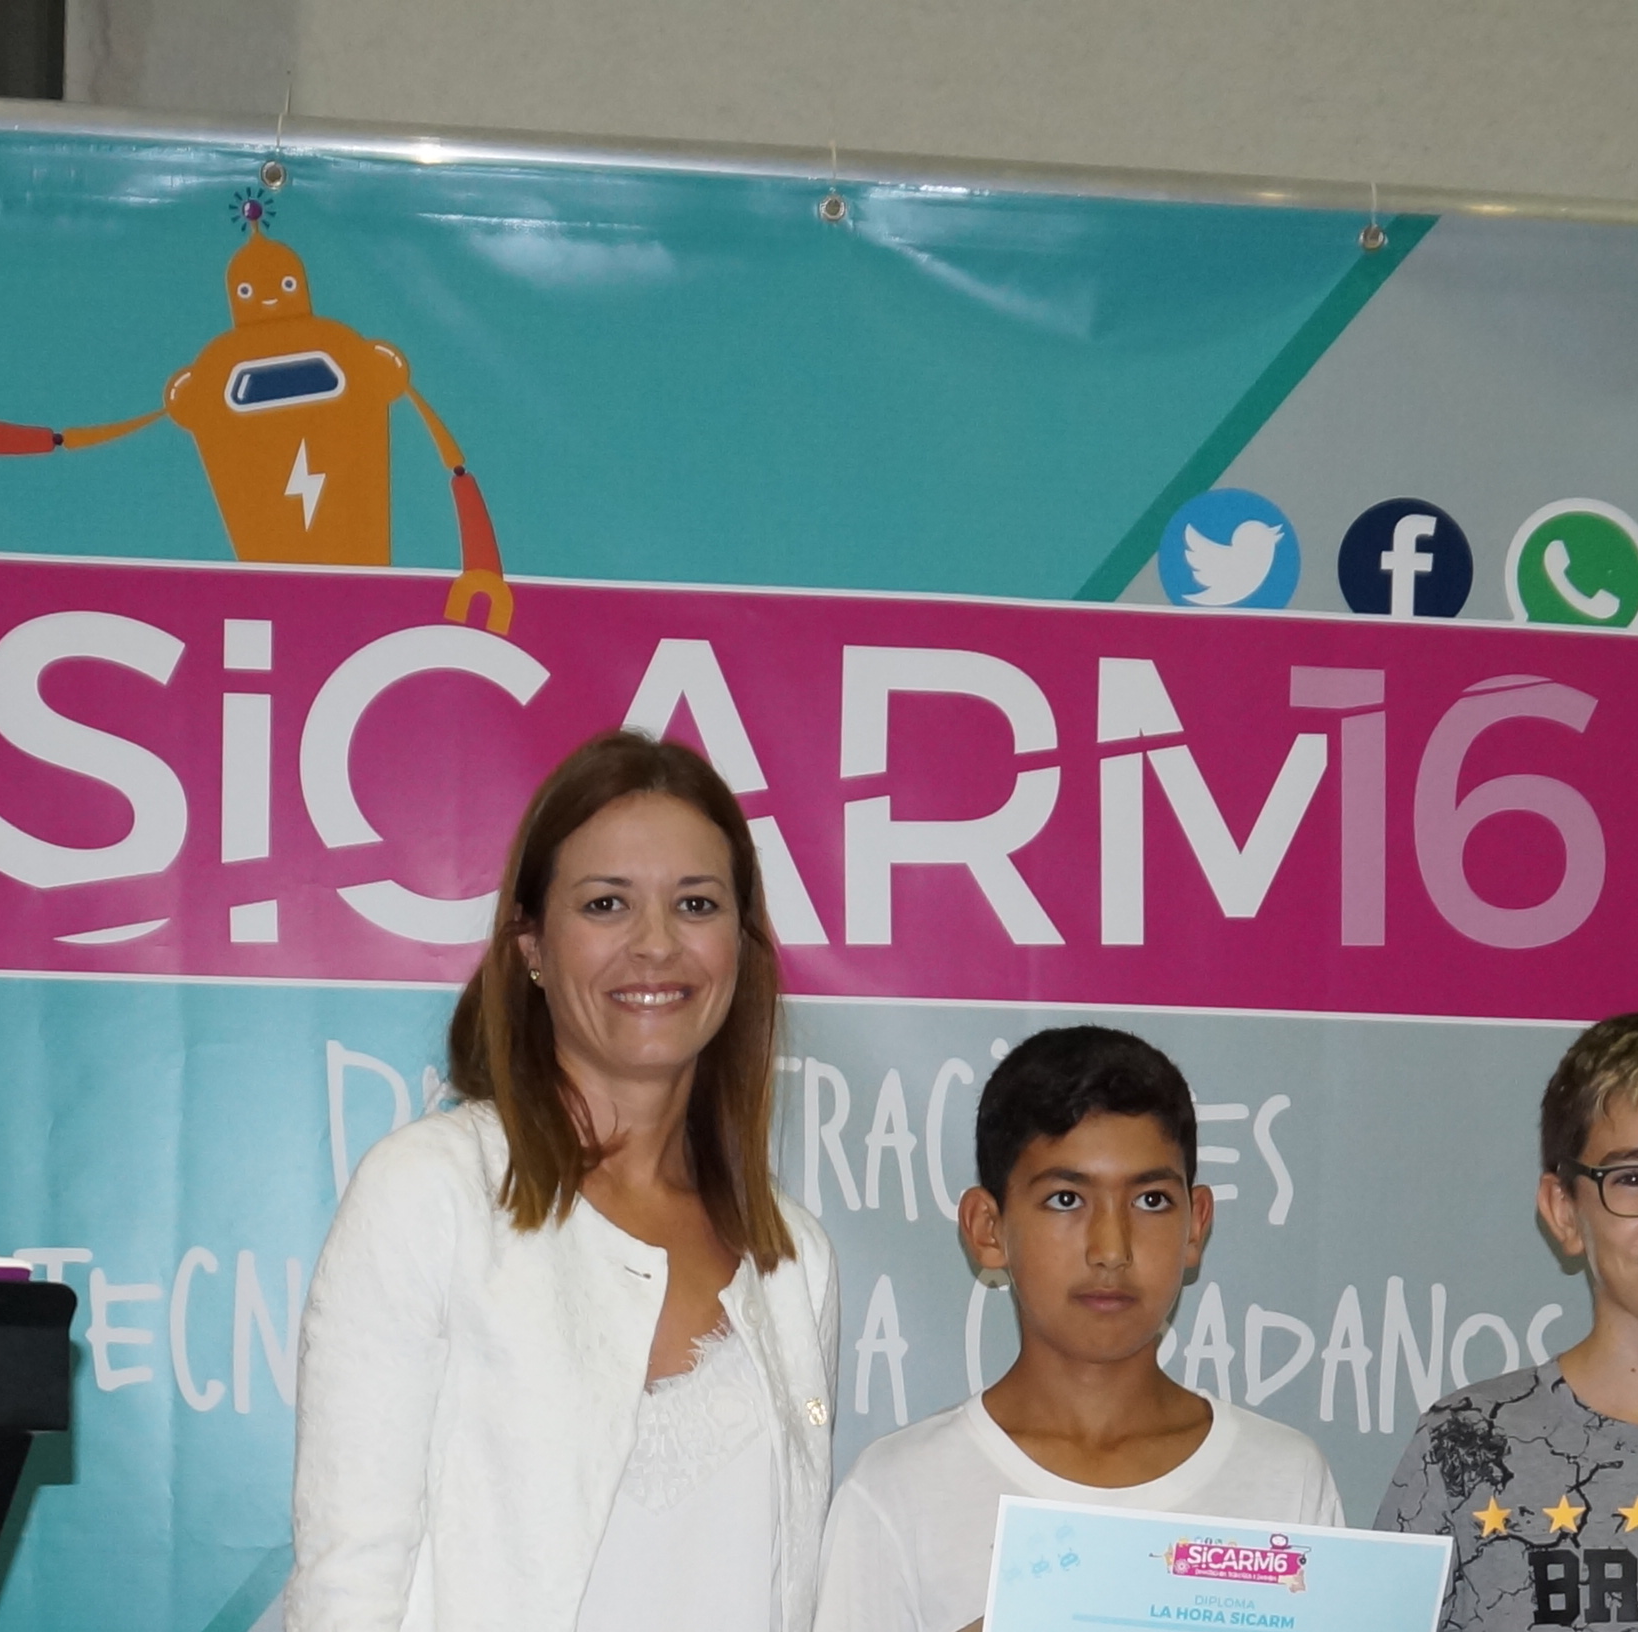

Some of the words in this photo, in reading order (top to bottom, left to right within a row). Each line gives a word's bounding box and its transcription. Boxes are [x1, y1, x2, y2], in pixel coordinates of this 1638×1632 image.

[1194, 1594, 1256, 1610] DIPLOMA
[1150, 1604, 1171, 1619] LA
[1176, 1607, 1225, 1624] HORA
[1230, 1611, 1295, 1629] SICARM
